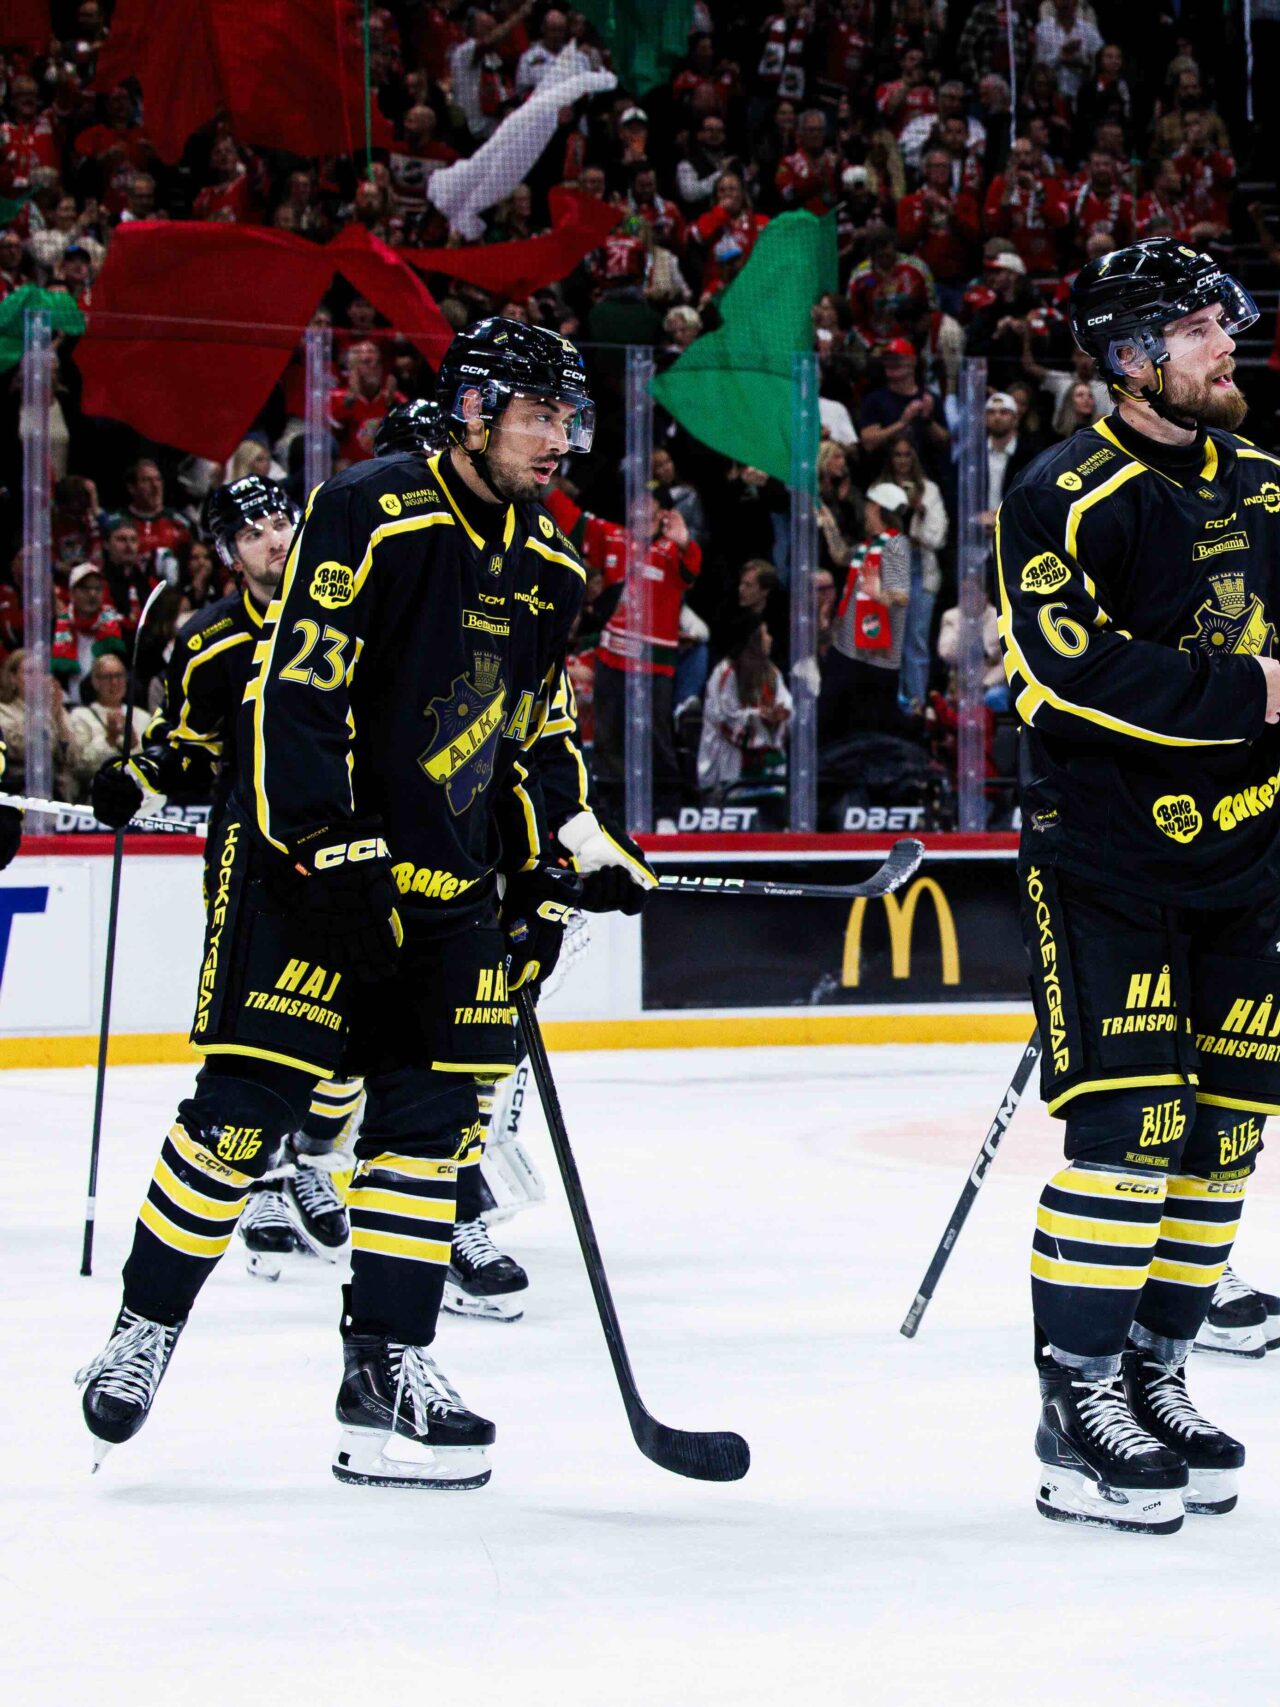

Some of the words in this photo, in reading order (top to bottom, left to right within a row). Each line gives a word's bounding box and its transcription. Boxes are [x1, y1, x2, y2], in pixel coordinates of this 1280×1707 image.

[1196, 270, 1221, 288] CCM
[1088, 313, 1113, 327] CCM
[460, 364, 489, 377] CCM
[563, 368, 587, 382] CCM
[1075, 447, 1110, 473] ADVANZIA
[1081, 450, 1117, 476] INSURANCE
[1204, 512, 1237, 530] CCM
[1038, 601, 1089, 658] 6
[279, 619, 350, 691] 23
[502, 690, 535, 741] A
[678, 807, 758, 831] DBET
[844, 806, 925, 830] DBET
[314, 837, 393, 870] CCM
[770, 888, 802, 897] BAUER
[194, 823, 241, 1034] HOCKEYGEAR
[1027, 865, 1070, 1074] HOCKEYGEAR
[1125, 963, 1177, 1009] HÅ
[244, 991, 343, 1032] TRANSPORTER
[507, 1067, 529, 1133] CCM
[970, 1086, 1023, 1189] CCM
[1139, 1115, 1186, 1148] CLUB
[195, 1151, 233, 1177] CCM
[437, 1165, 457, 1174] CC
[1115, 1181, 1160, 1195] CCM
[1207, 1182, 1245, 1194] CCM
[1142, 1501, 1162, 1512] CCM
